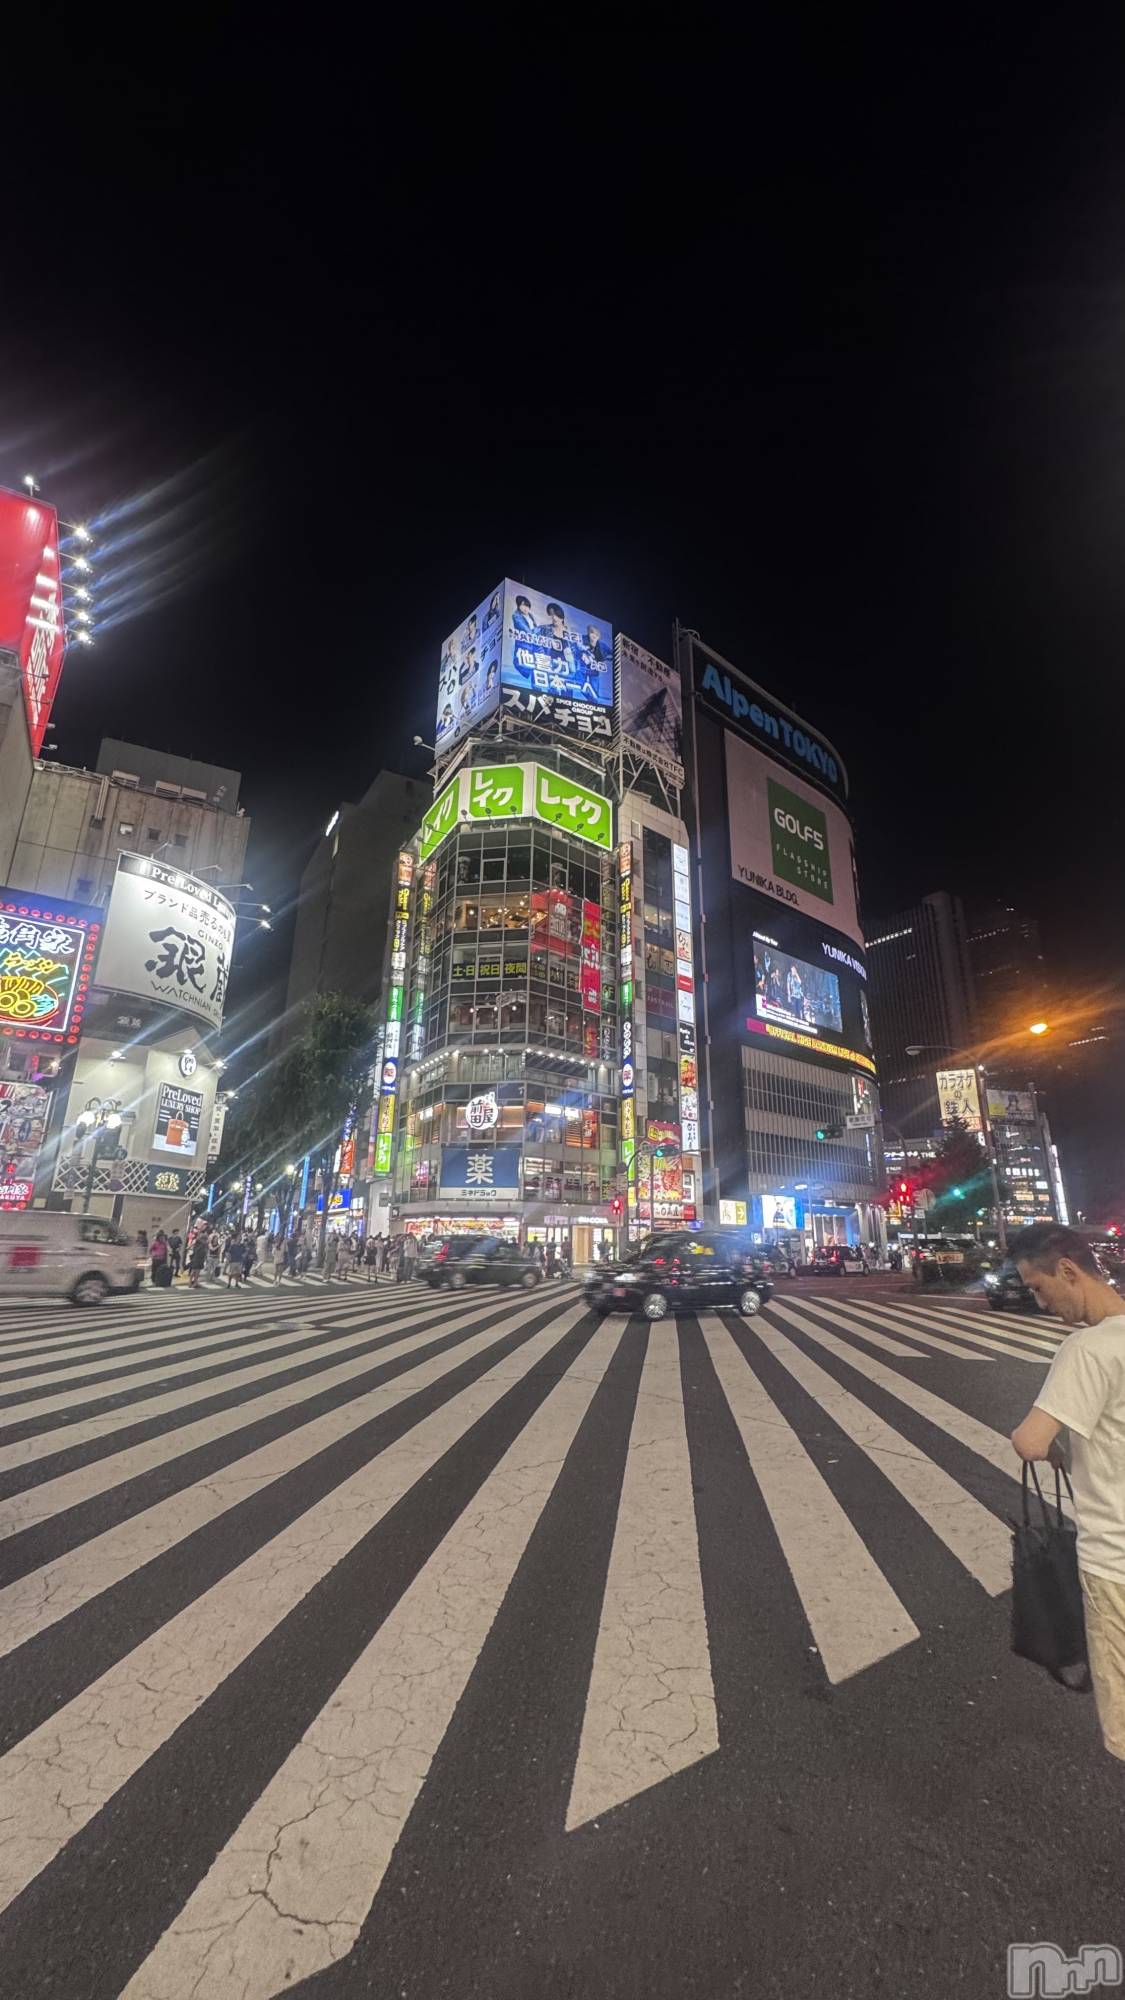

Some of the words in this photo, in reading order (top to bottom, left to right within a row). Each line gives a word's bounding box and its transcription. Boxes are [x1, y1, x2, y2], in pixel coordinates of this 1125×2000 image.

[534, 671, 598, 698] 日本一へ
[572, 701, 606, 713] CHOCOLATE
[702, 664, 780, 740] Alpen
[781, 720, 837, 783] TOKYO
[473, 772, 513, 808] レイク
[541, 778, 602, 824] レイク
[774, 808, 824, 850] GOLF5
[776, 844, 828, 876] FLAGSHIP
[737, 864, 776, 894] YUNIKA
[797, 867, 828, 890] STORE
[821, 942, 852, 967] YUNIKA
[505, 962, 527, 974] 夜間
[151, 981, 211, 1012] WATCHNIAN
[939, 1072, 974, 1090] カラオケ
[161, 1099, 185, 1112] LUXURY
[185, 1104, 201, 1115] SHOP
[162, 1084, 202, 1107] PreLoved
[944, 1099, 974, 1115] 鉄人
[954, 1090, 962, 1099] の
[465, 1154, 494, 1184] 薬
